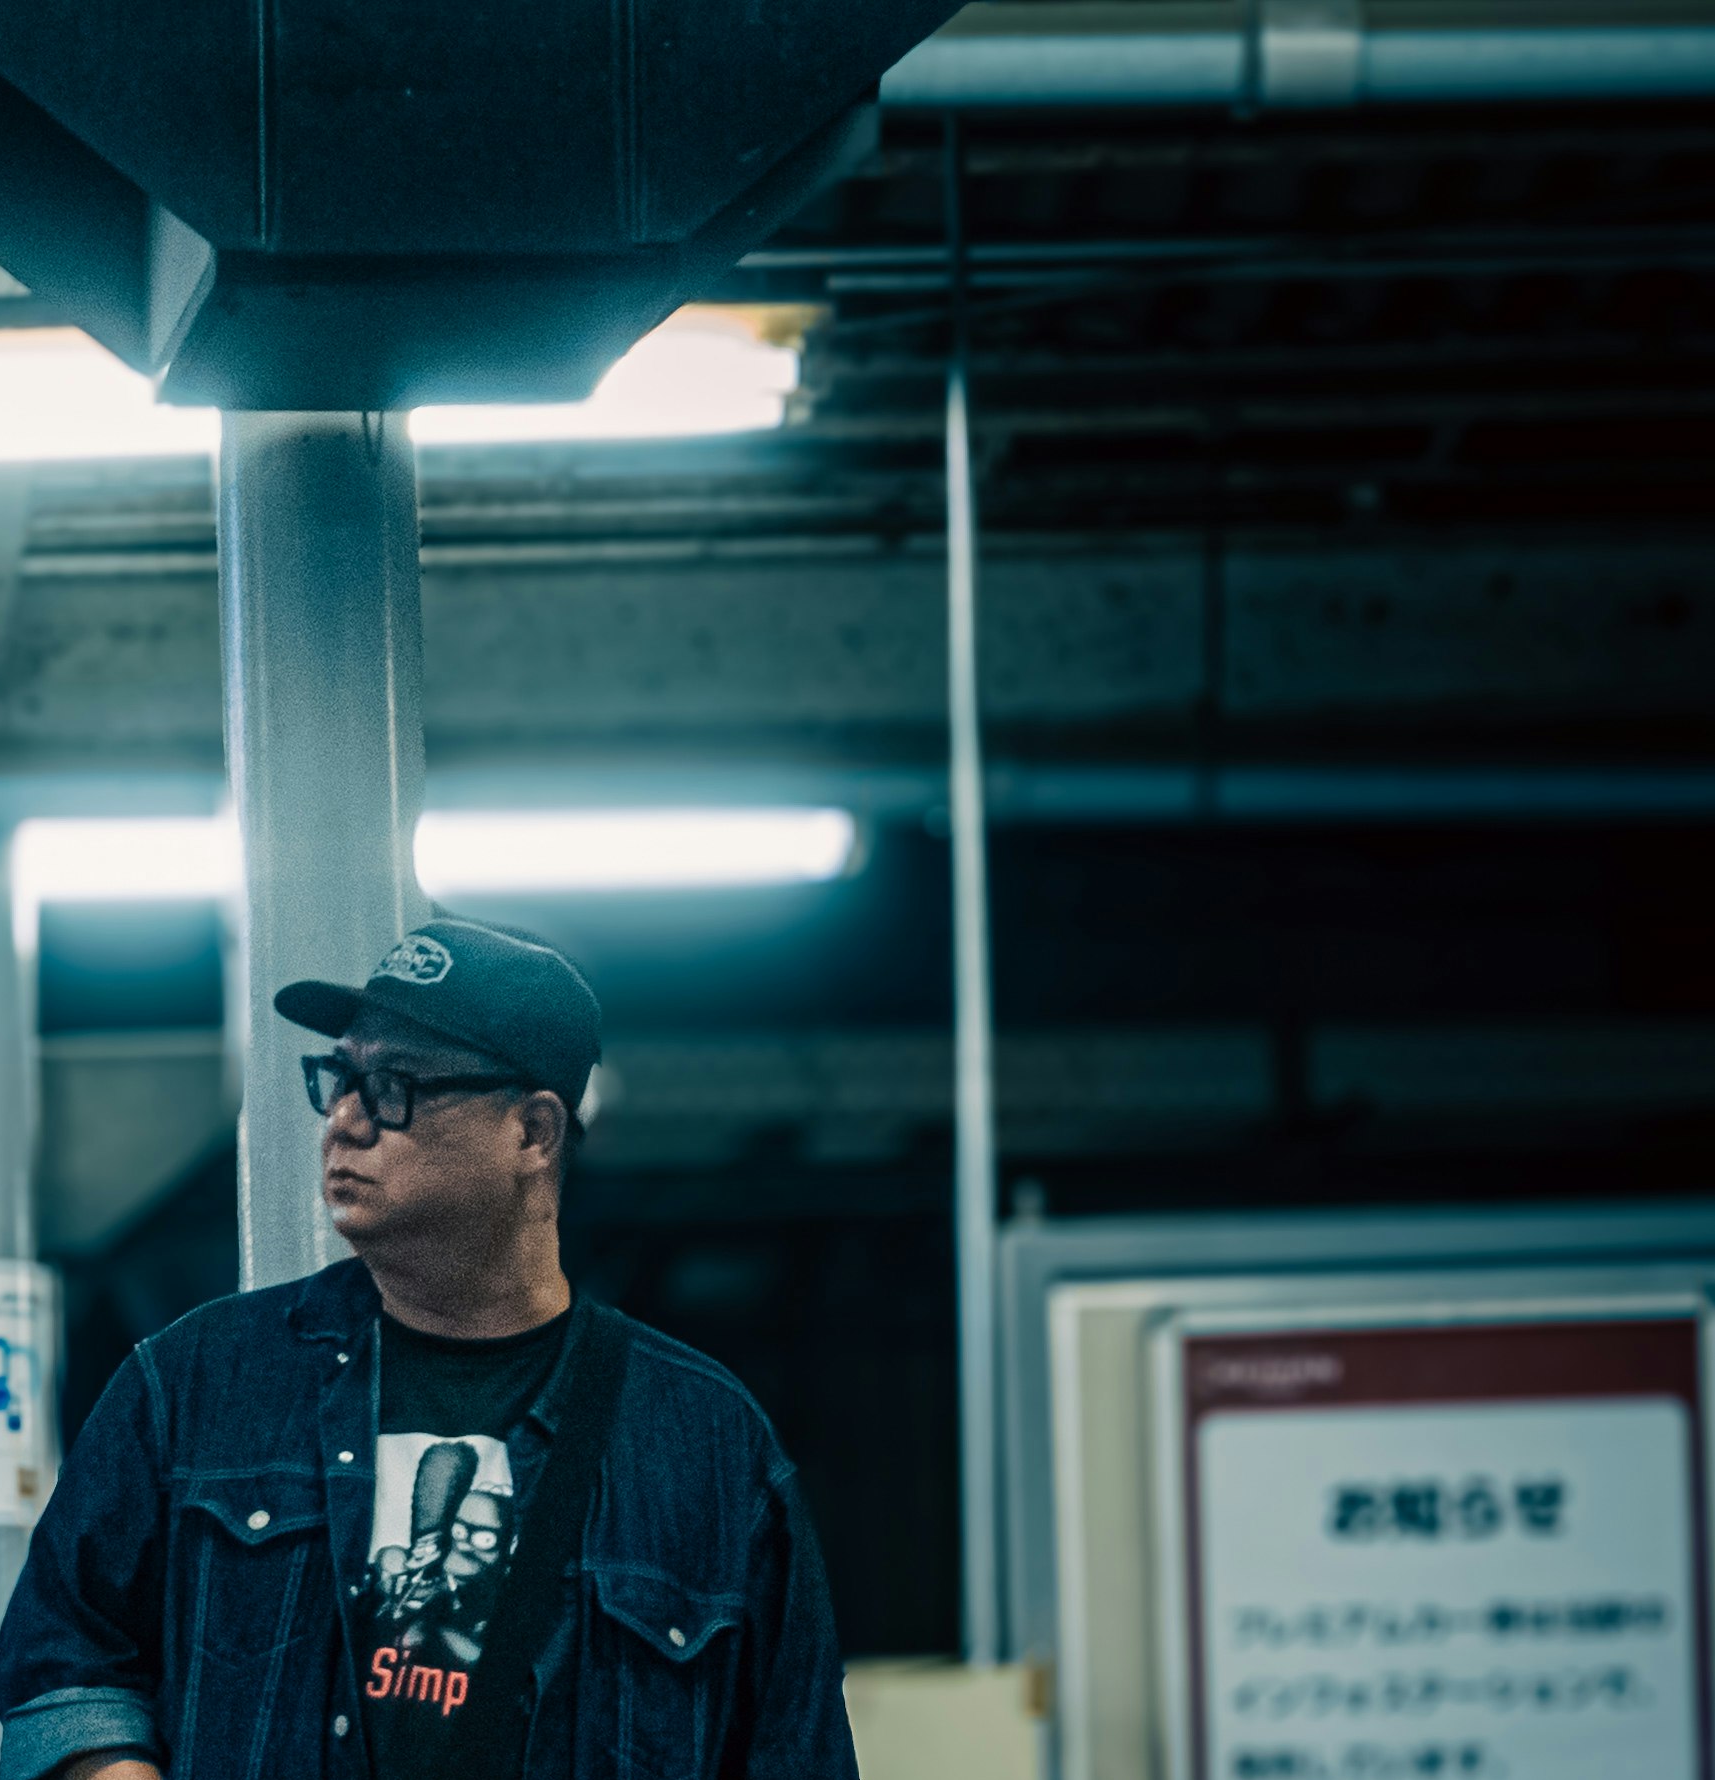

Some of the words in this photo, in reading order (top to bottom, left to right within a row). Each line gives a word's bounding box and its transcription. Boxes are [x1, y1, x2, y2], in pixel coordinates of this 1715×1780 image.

[1332, 1475, 1563, 1540] お知らせ
[366, 1646, 469, 1717] Simp
